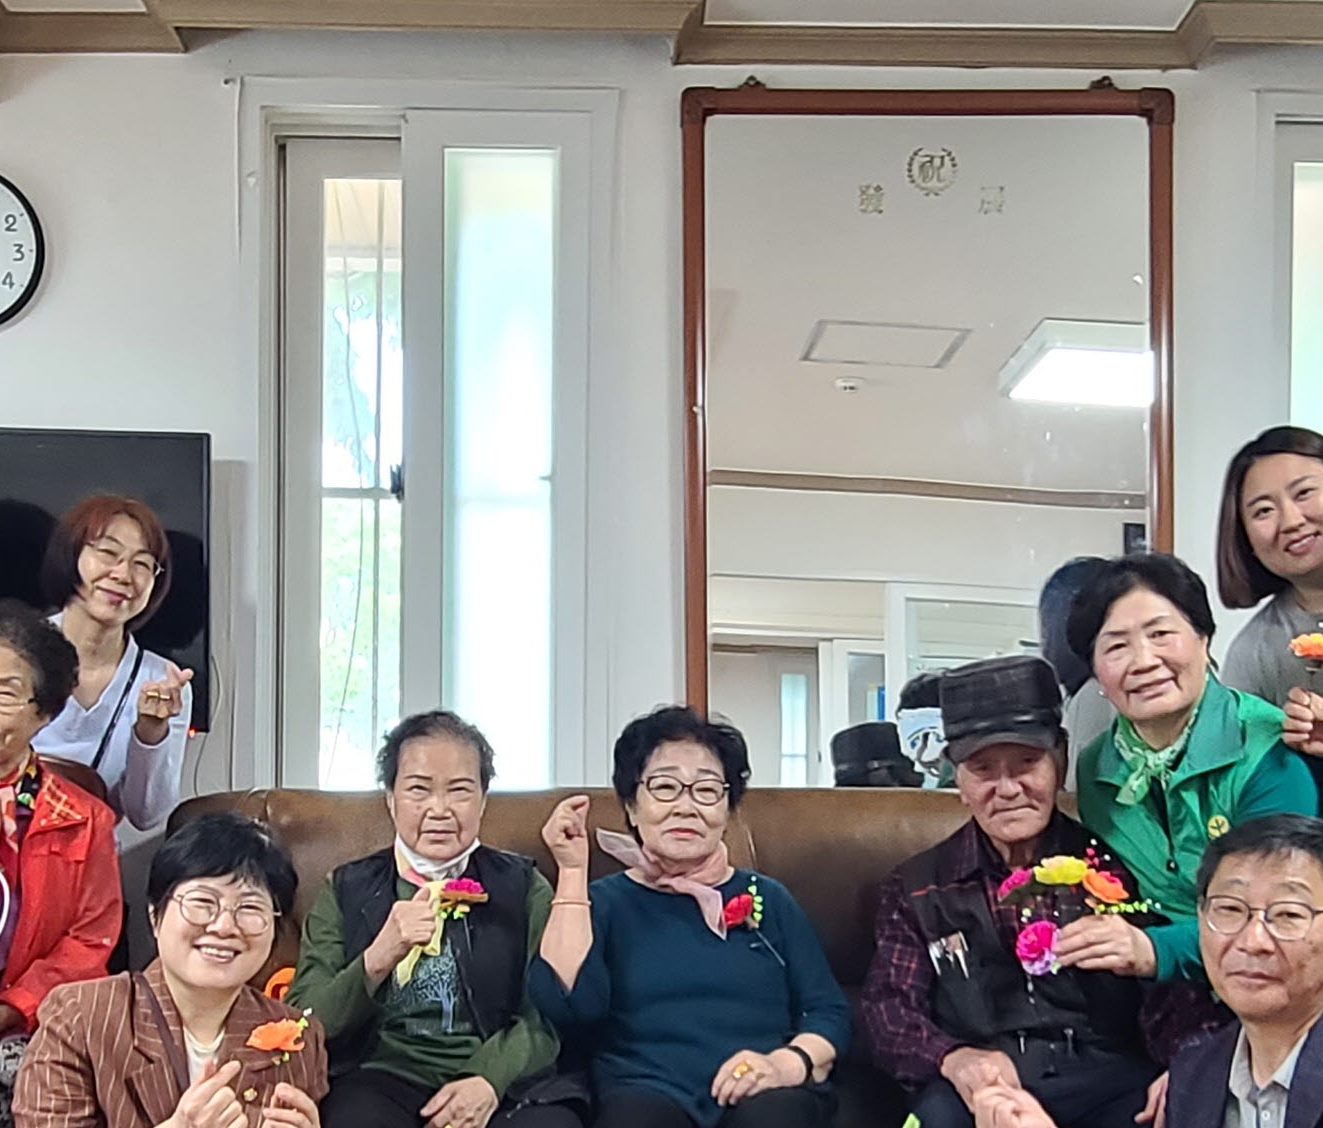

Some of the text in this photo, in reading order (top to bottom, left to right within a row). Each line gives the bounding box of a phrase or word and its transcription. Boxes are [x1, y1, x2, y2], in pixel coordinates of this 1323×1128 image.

[4, 214, 18, 232] 2
[12, 243, 25, 262] 3
[1, 272, 15, 289] 4
